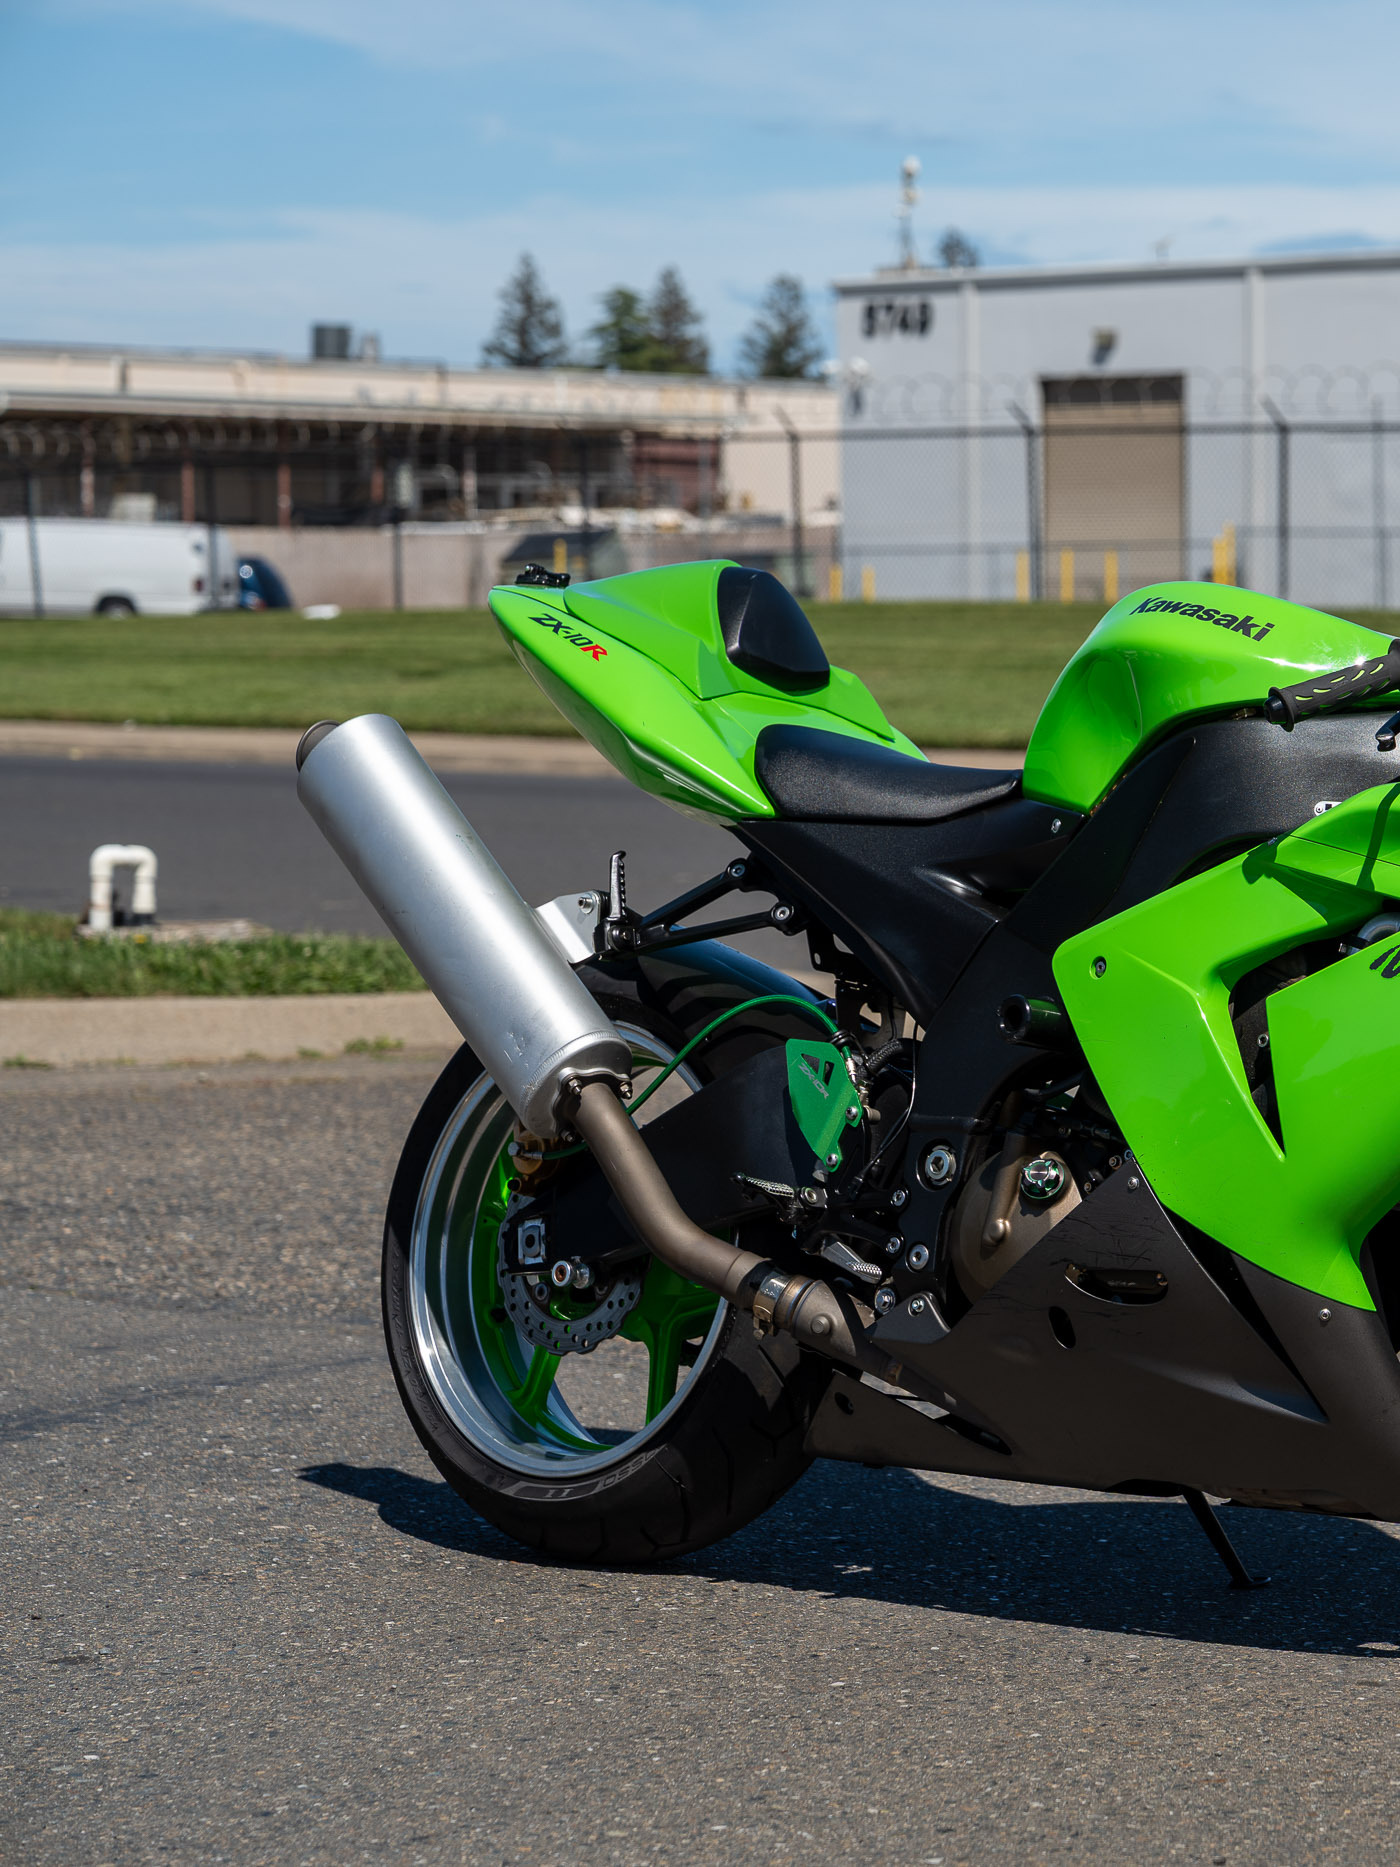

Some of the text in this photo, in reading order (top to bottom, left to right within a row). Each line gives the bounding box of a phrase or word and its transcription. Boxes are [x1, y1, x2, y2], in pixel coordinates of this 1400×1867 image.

[527, 612, 609, 662] ZX-10R
[1129, 596, 1276, 642] Kawasaki
[797, 1061, 830, 1101] ZX-10R
[601, 1449, 660, 1489] OSSO
